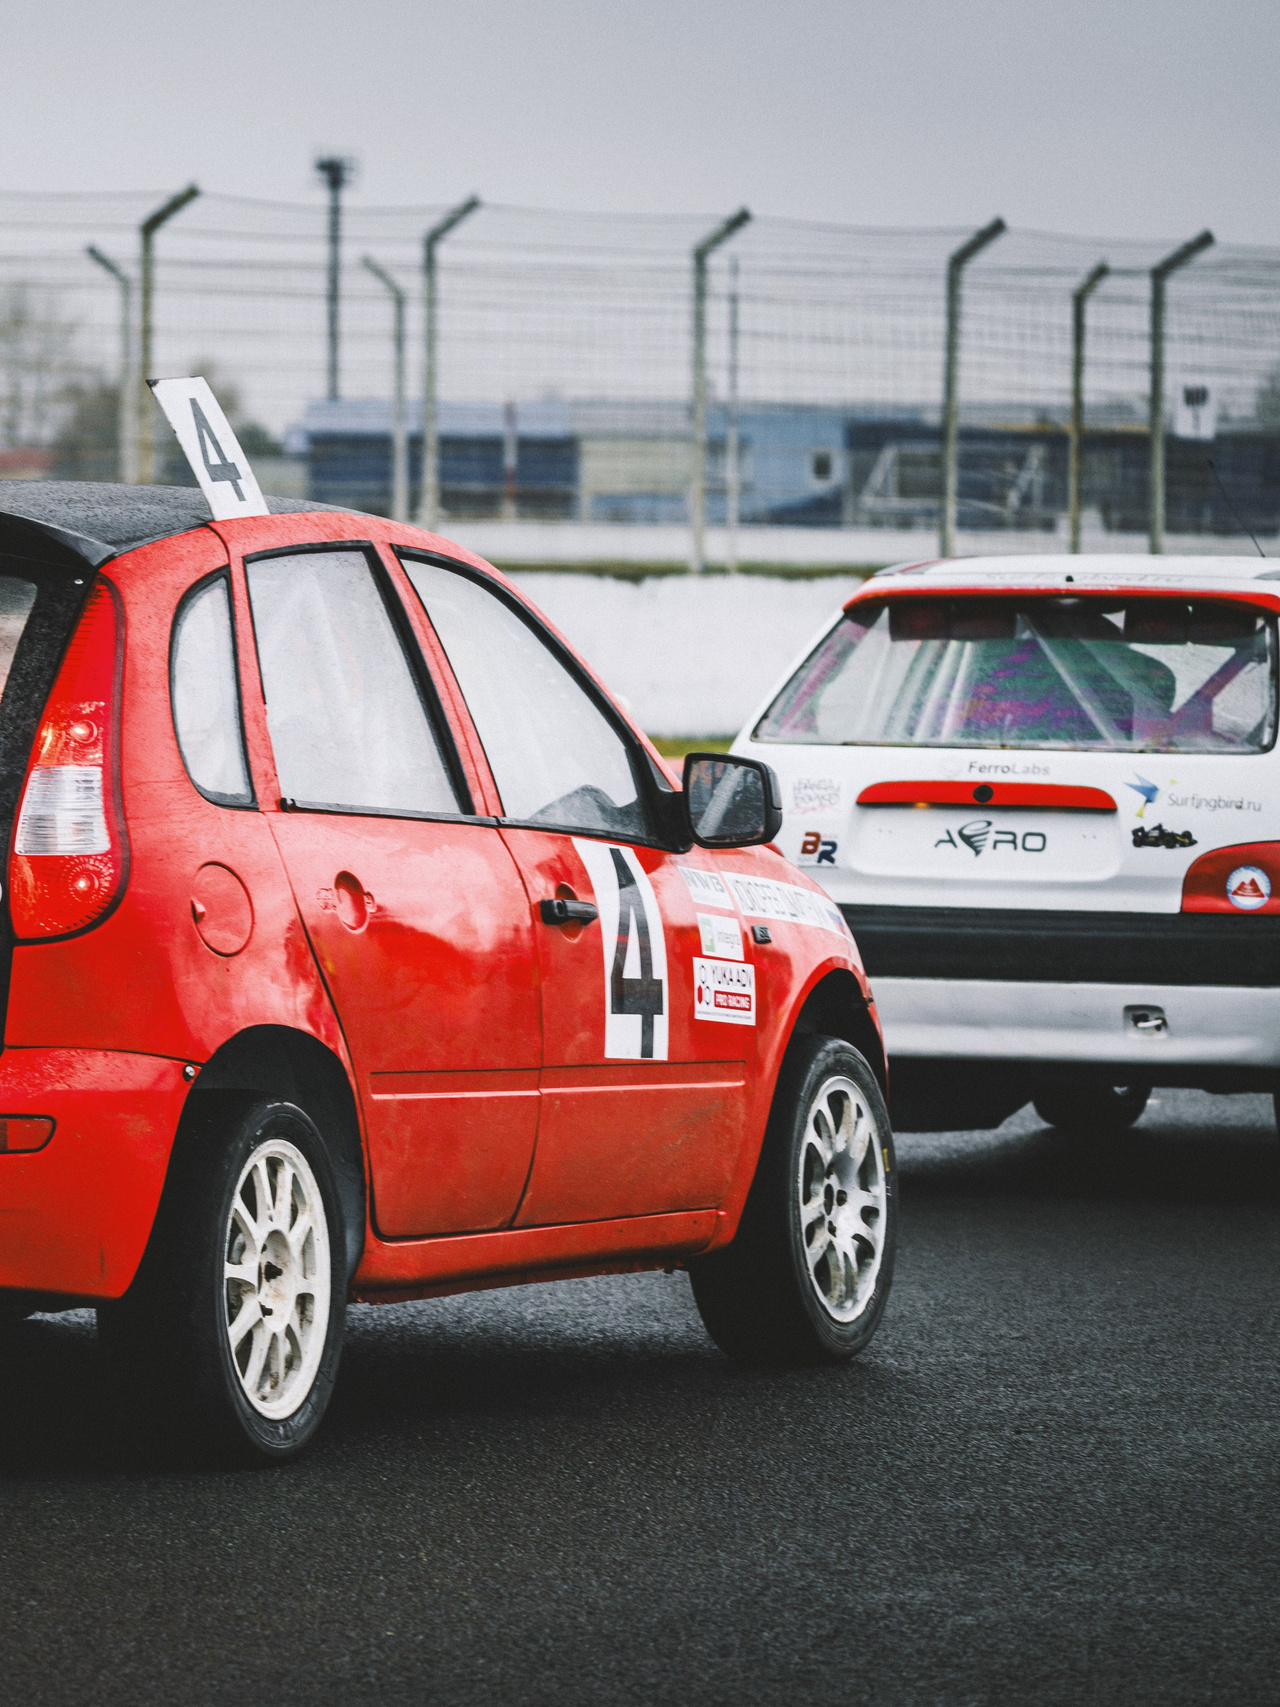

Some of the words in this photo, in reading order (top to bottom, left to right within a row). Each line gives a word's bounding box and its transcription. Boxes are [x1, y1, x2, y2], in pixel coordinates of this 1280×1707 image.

[189, 398, 246, 501] 4
[967, 761, 1051, 775] FerroLabs
[1167, 793, 1263, 813] Surfingbird.ru
[609, 848, 664, 1059] 4
